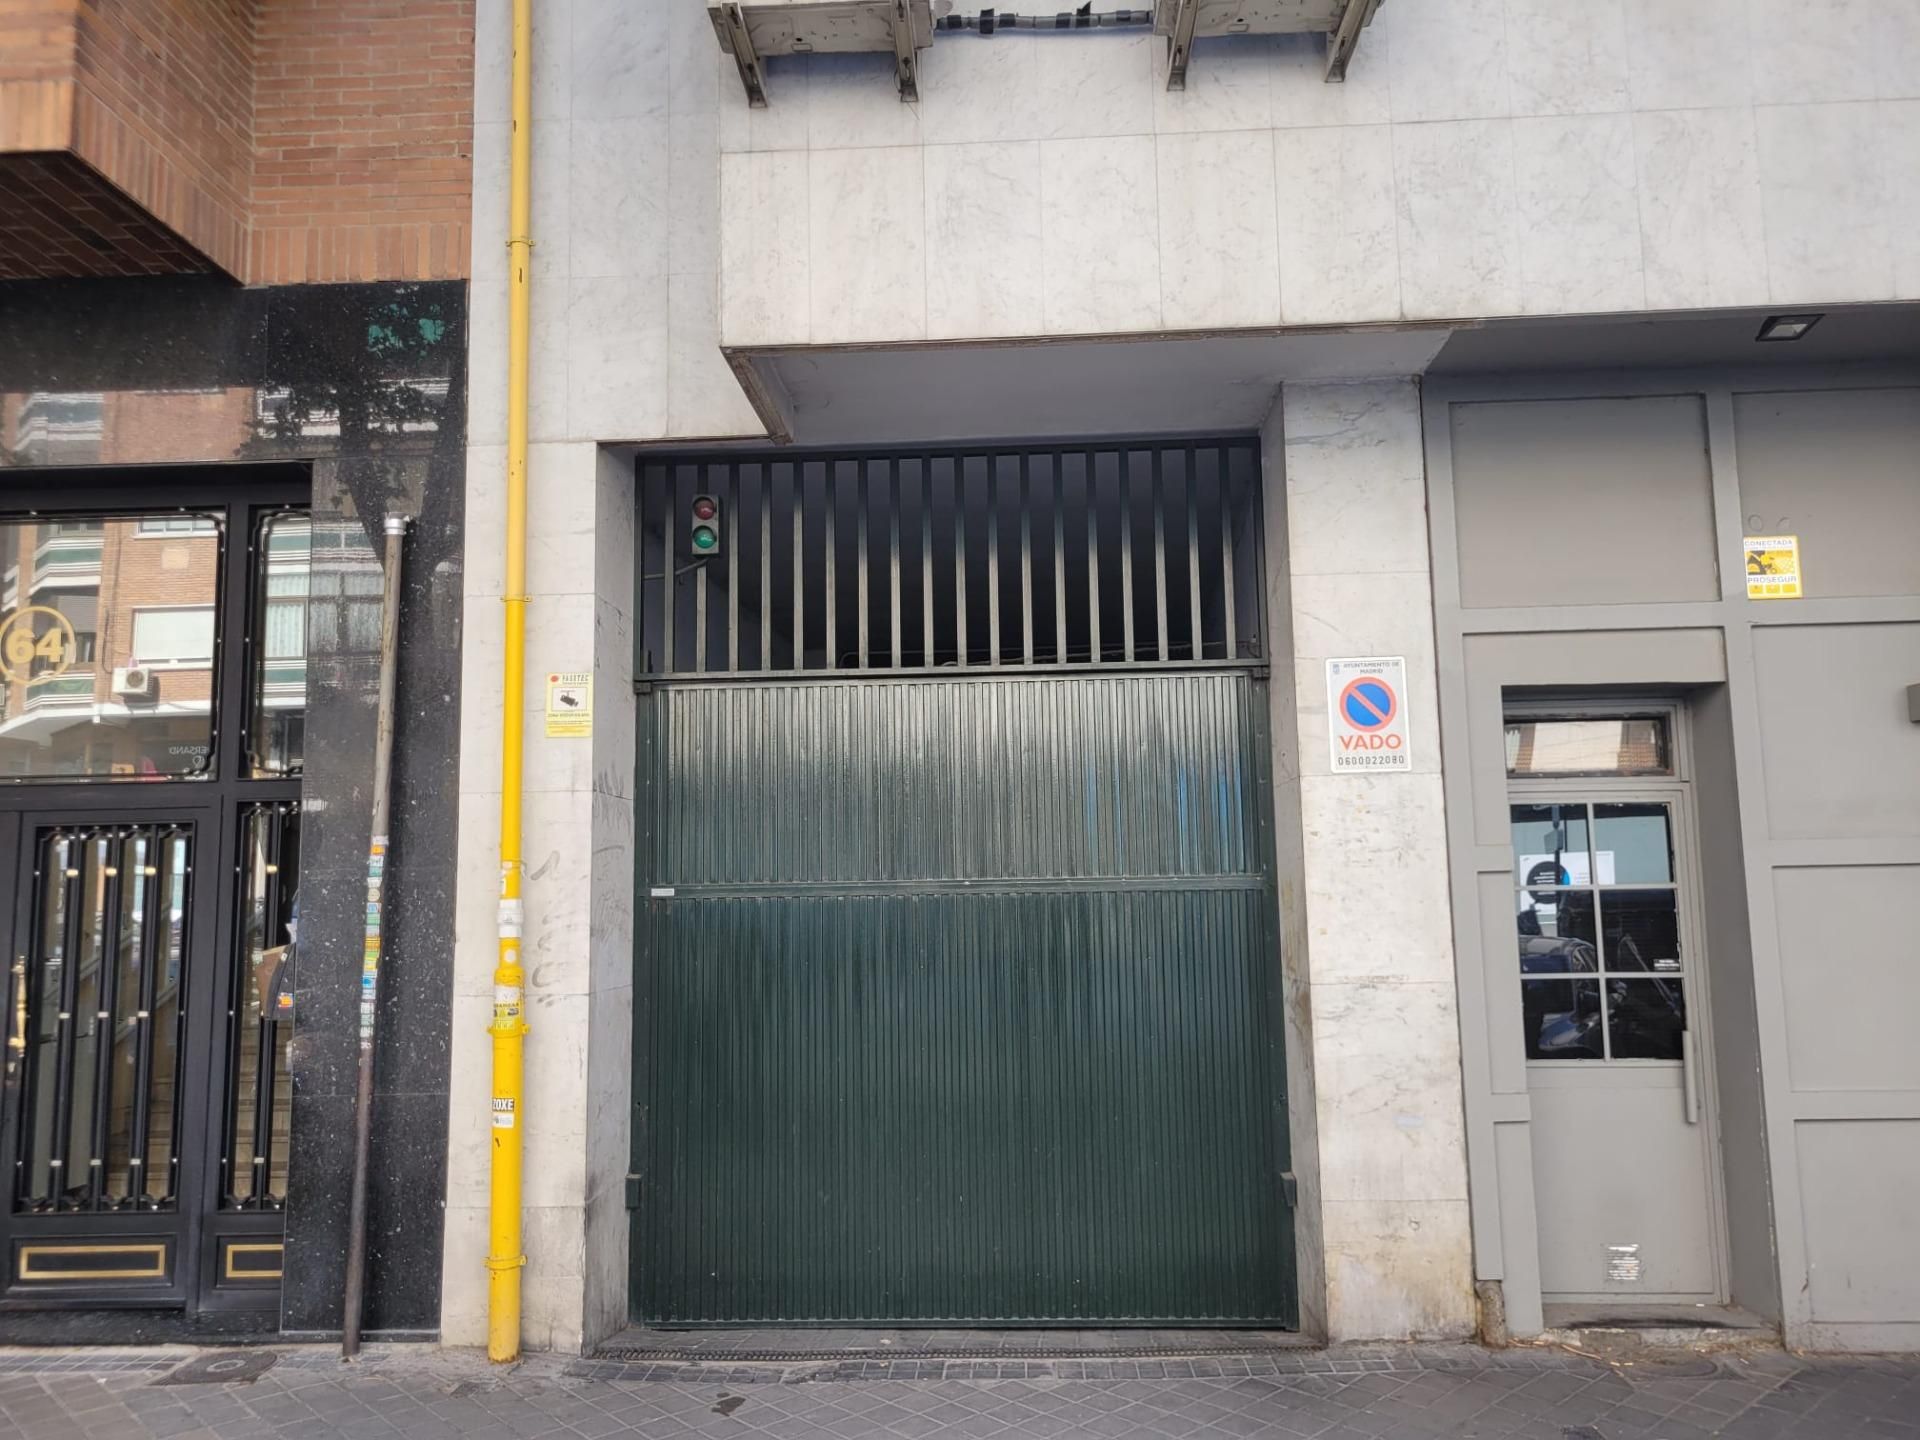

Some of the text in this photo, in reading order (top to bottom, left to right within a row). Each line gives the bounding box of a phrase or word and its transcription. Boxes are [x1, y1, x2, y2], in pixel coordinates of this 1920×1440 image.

[1747, 576, 1797, 584] PROSEGUR
[6, 628, 64, 664] 64
[1339, 734, 1402, 751] VADO
[1338, 755, 1405, 766] 0600022080
